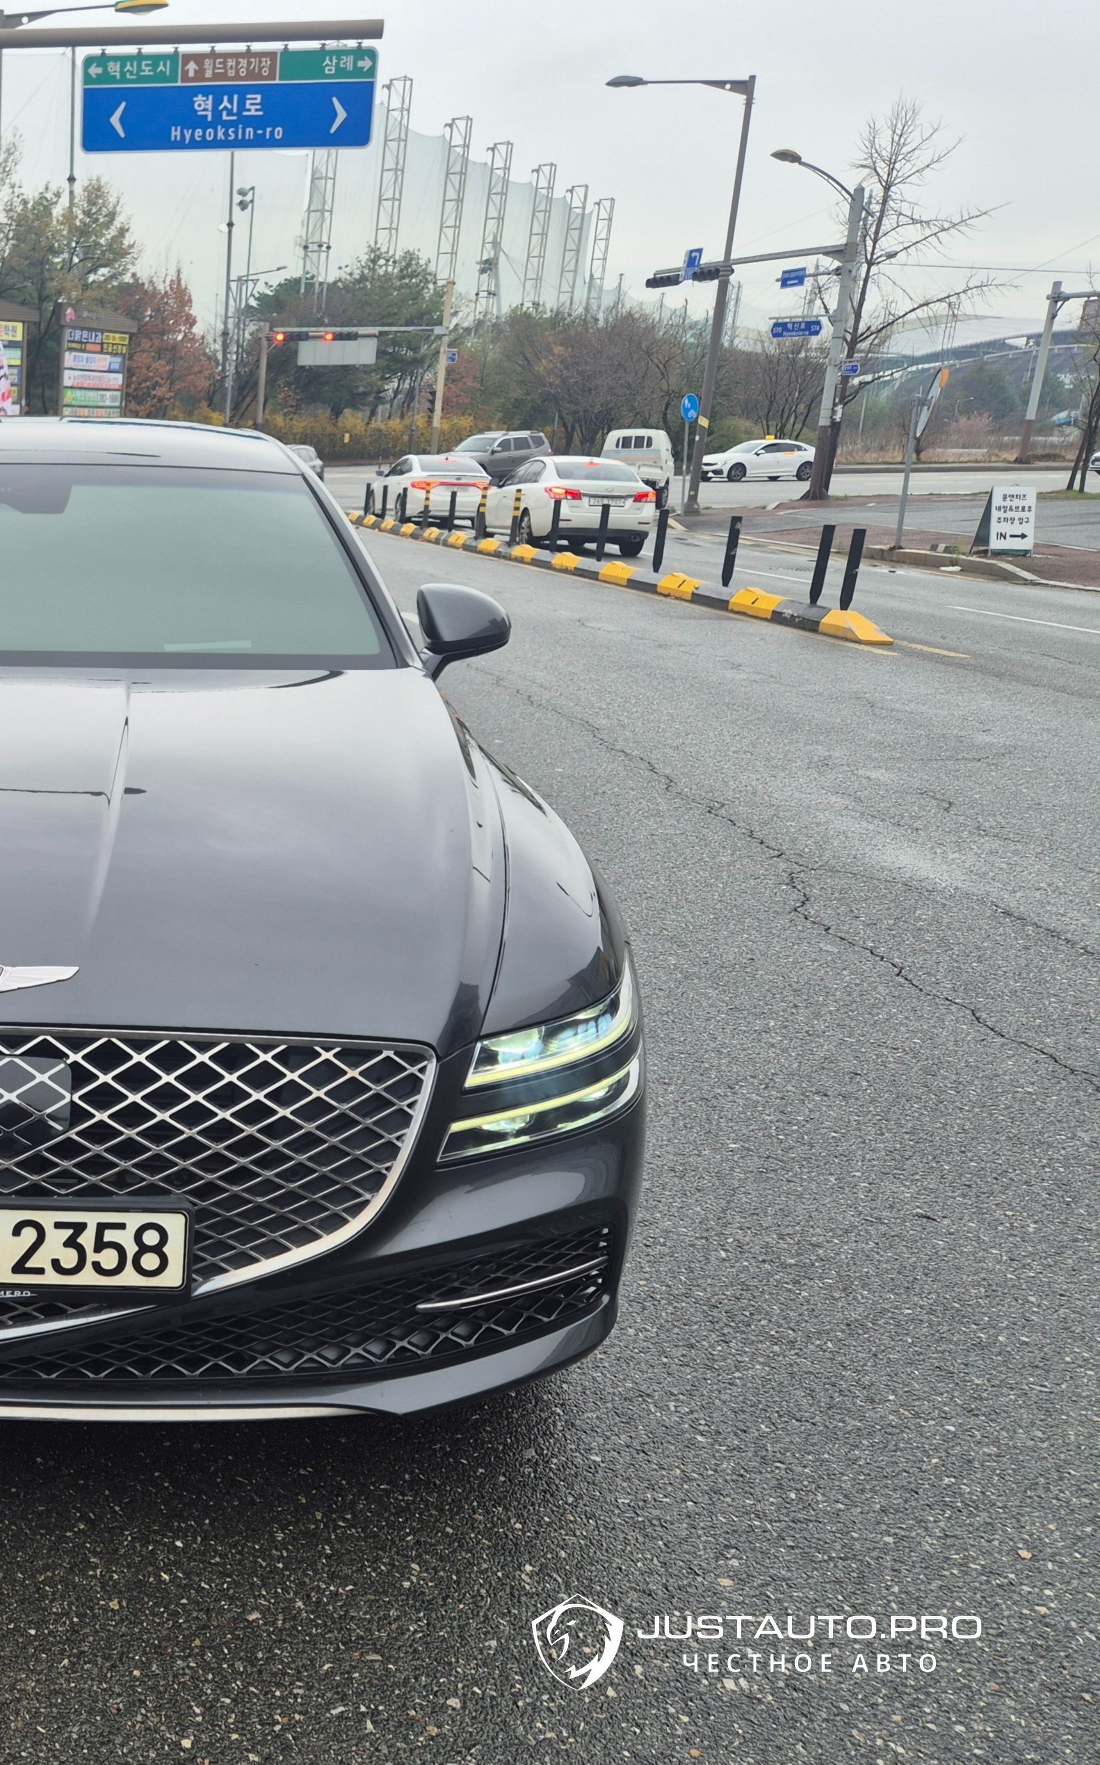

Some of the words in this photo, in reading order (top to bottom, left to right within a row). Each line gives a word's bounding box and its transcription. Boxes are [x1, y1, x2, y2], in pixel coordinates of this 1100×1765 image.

[107, 60, 171, 79] 혁신도시
[203, 57, 272, 78] 월드컵경기장
[323, 55, 354, 75] 삼례
[192, 94, 264, 121] 혁신로
[170, 125, 283, 145] Hyeoksin-ro
[787, 322, 806, 330] 혁신로
[996, 517, 1015, 525] 주차장
[1018, 517, 1030, 525] 입구
[996, 532, 1007, 541] IN
[11, 1218, 170, 1279] 2358
